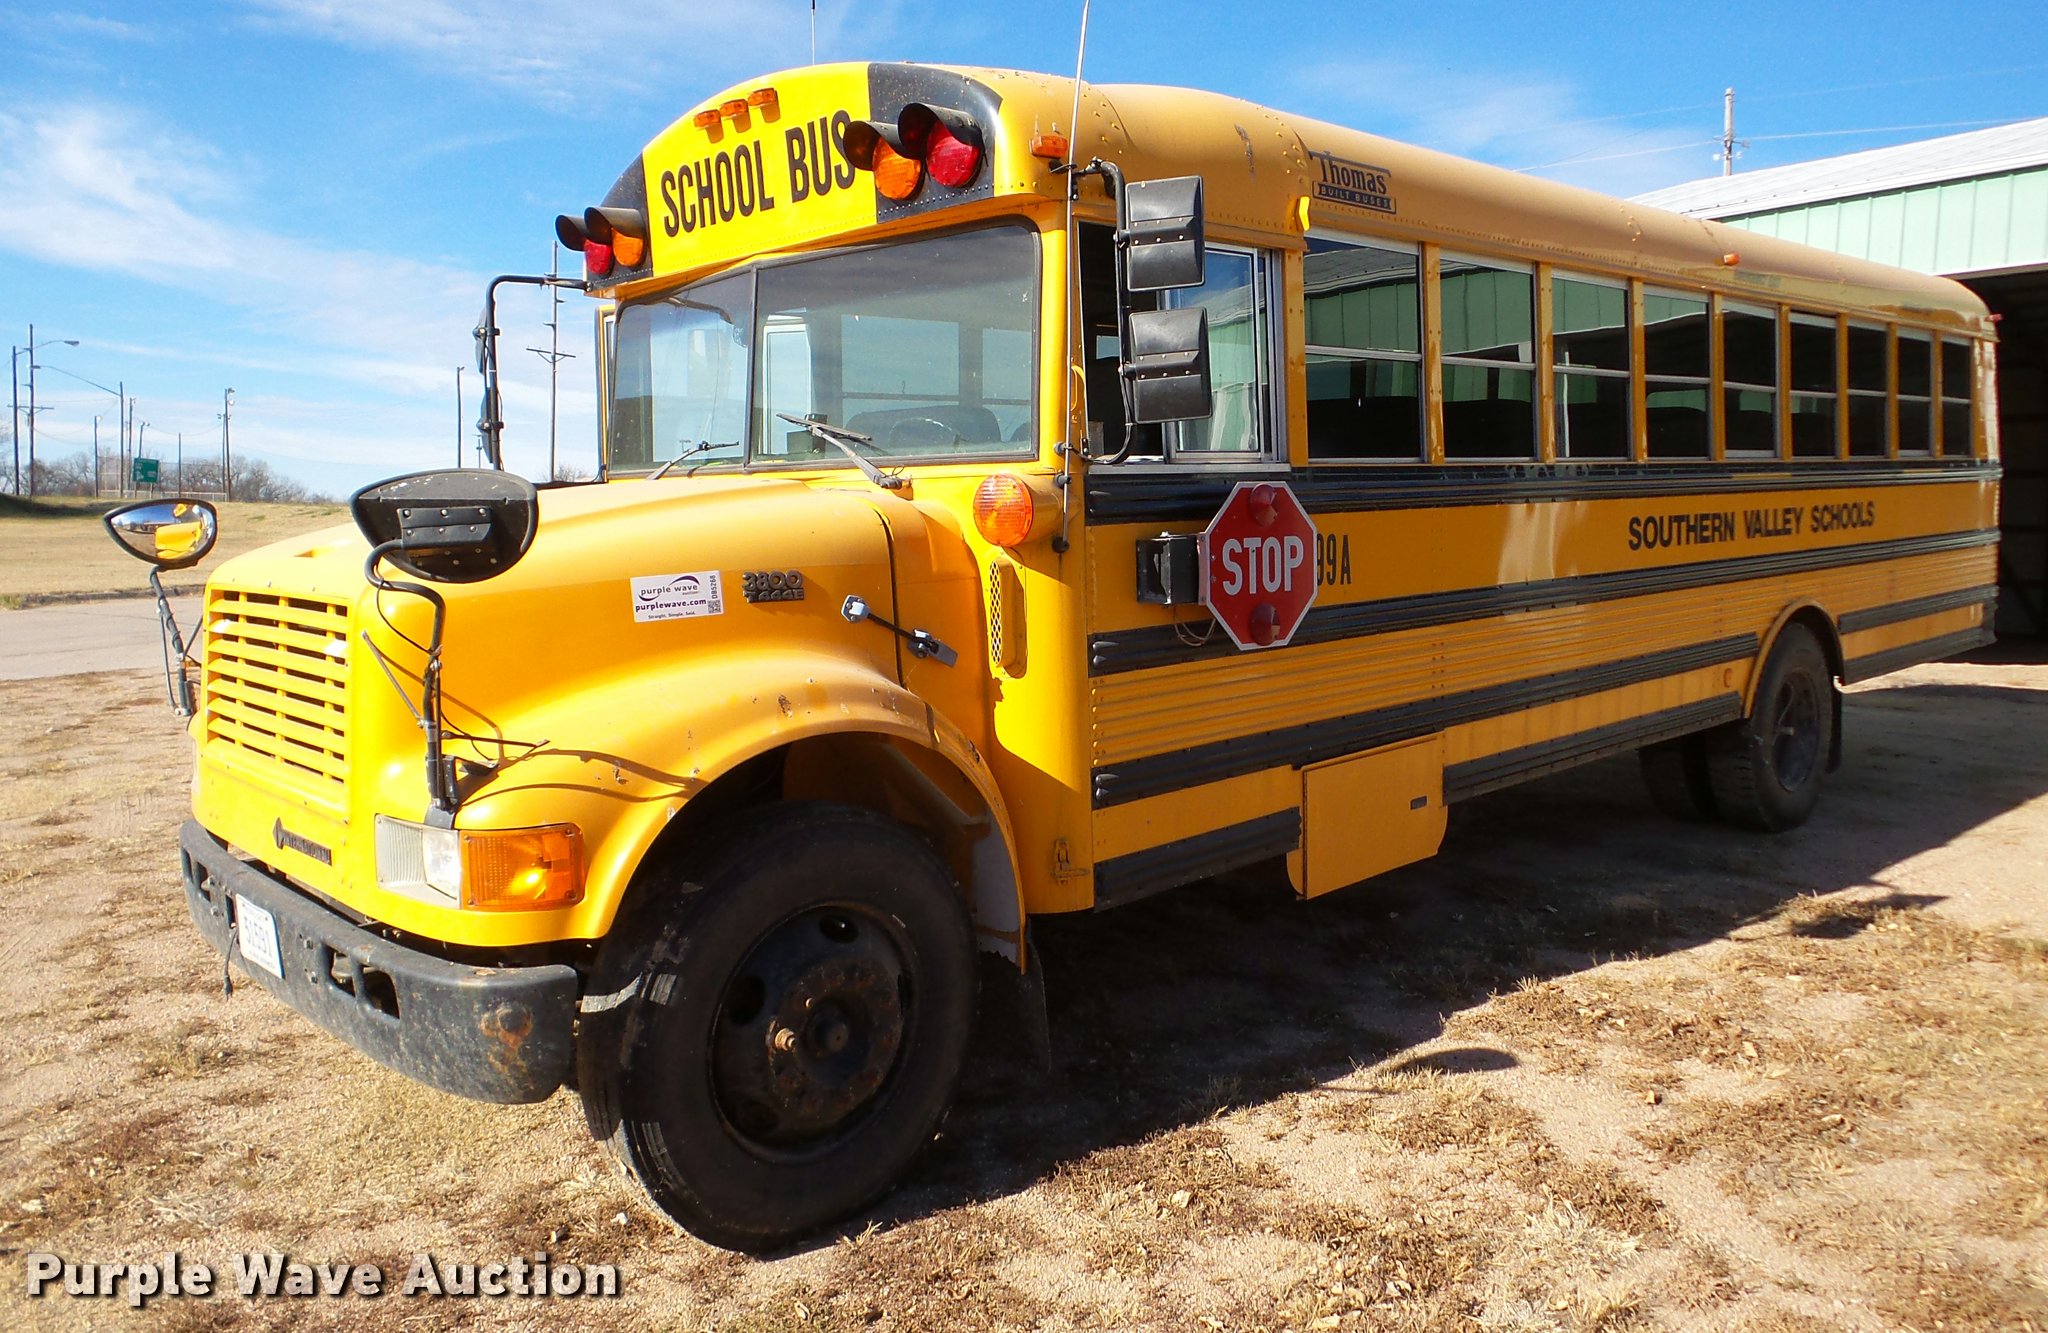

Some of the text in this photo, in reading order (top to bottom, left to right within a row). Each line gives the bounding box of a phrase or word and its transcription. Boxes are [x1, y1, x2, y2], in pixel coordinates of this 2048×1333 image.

[661, 110, 856, 238] SCHOOL BUS
[1310, 152, 1390, 195] Thomas
[1321, 186, 1388, 207] BUILT BUSES
[1628, 501, 1876, 551] SOUTHERN VALLEY SCHOOLS
[742, 570, 802, 591] 3800
[1222, 535, 1304, 596] STOP
[635, 599, 707, 613] purplewave.com
[640, 584, 698, 597] purple wave
